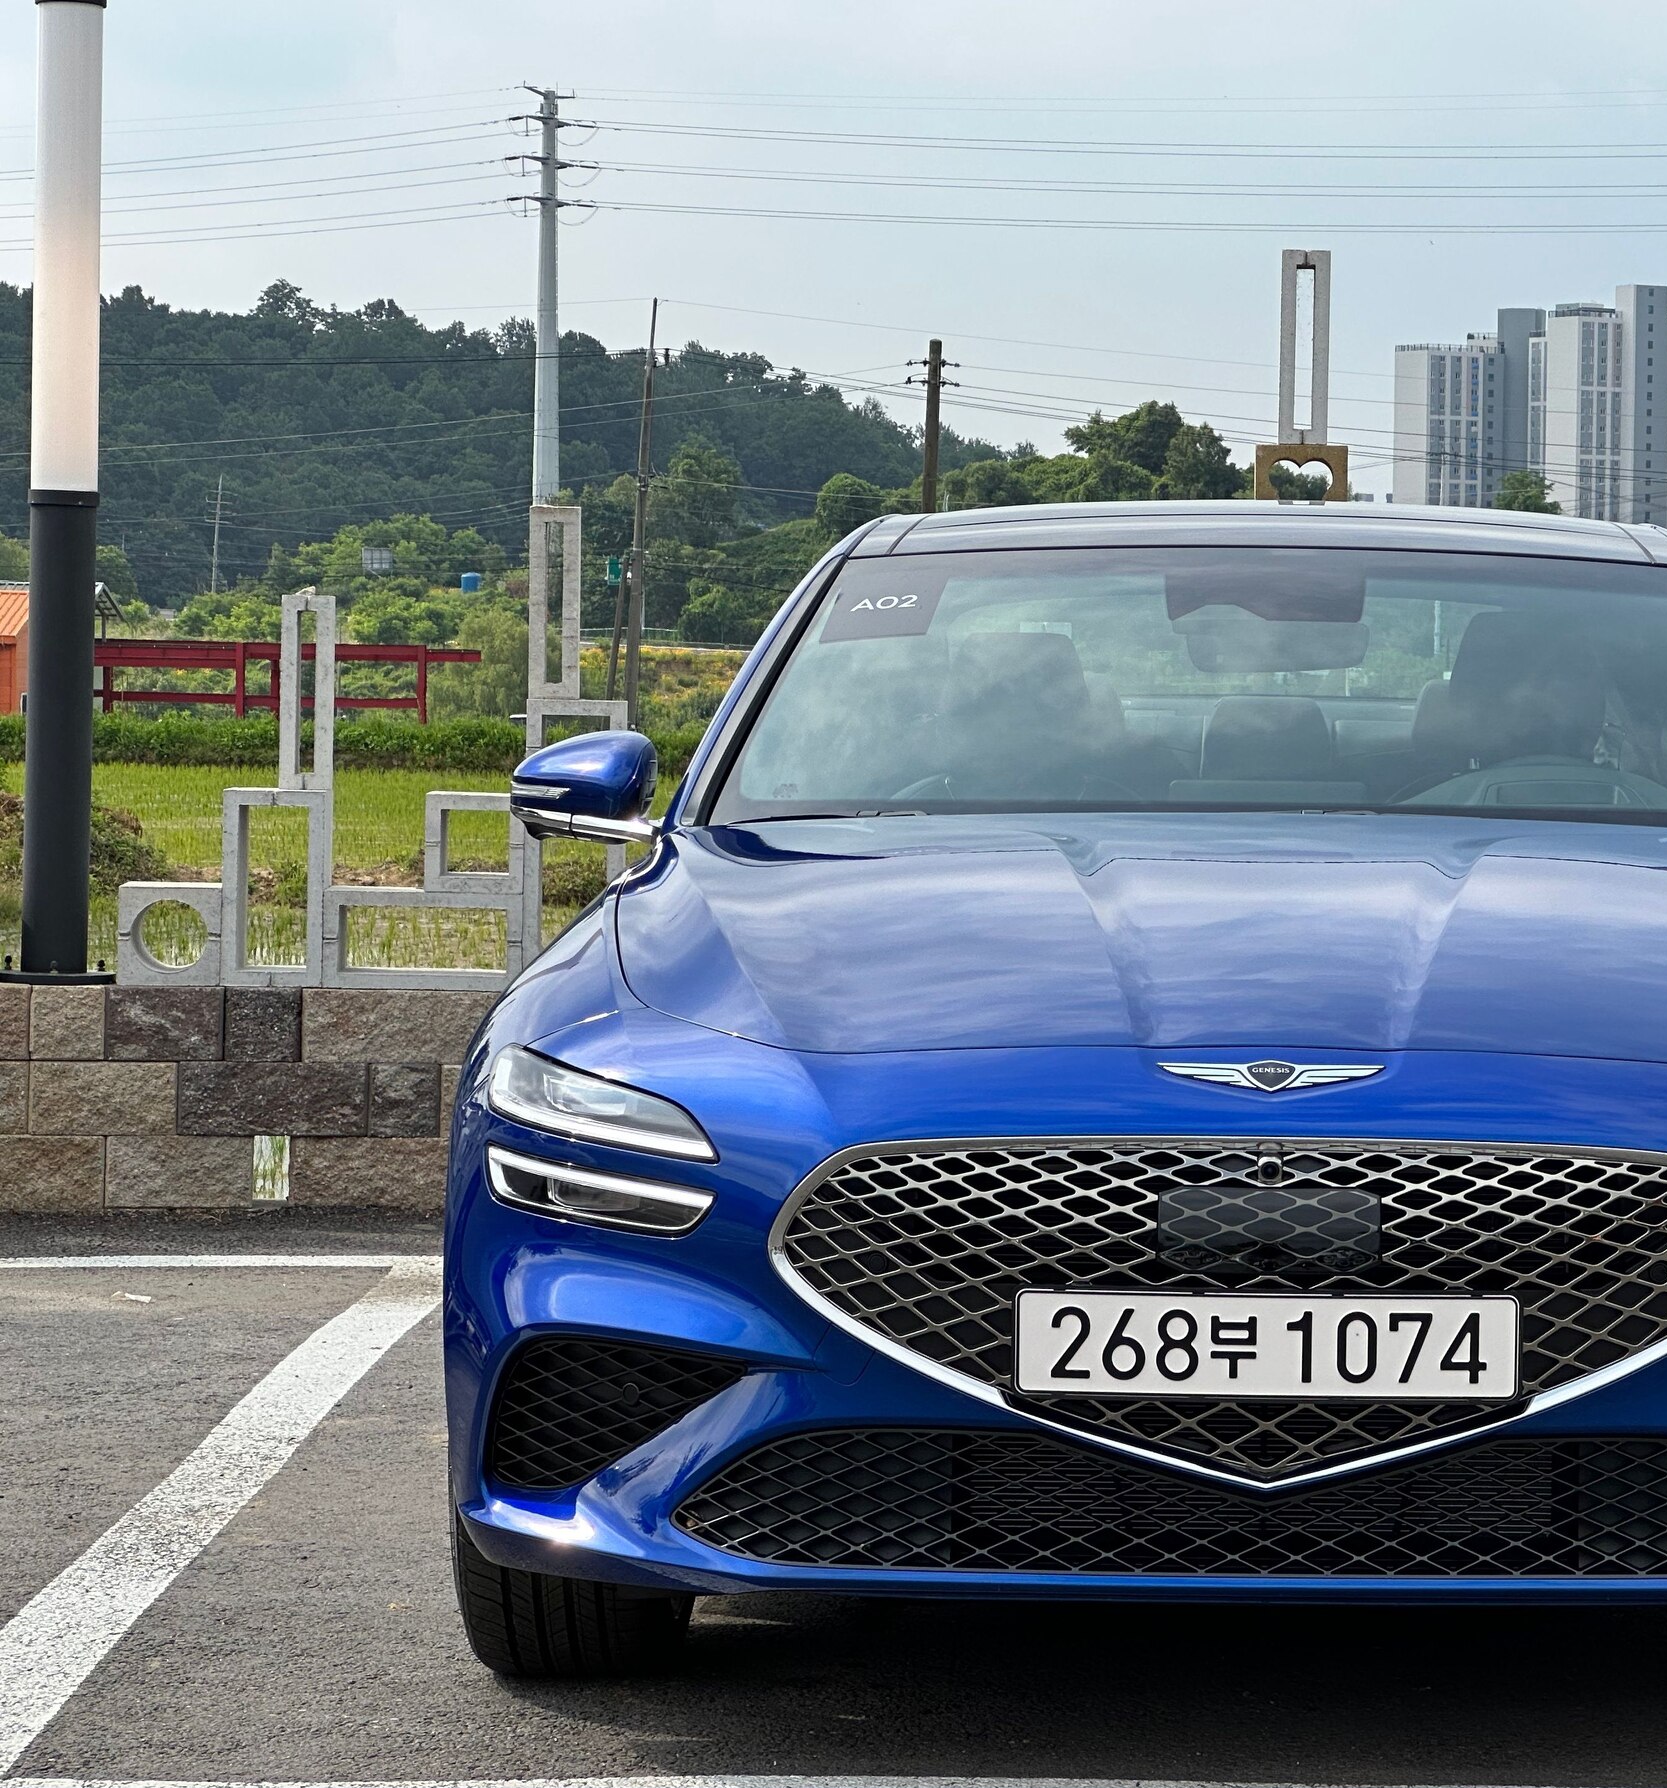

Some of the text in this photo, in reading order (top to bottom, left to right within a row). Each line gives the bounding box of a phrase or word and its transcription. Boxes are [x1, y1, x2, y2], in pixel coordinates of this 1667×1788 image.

[850, 594, 918, 612] A02
[1050, 1306, 1488, 1385] 268부 1074
